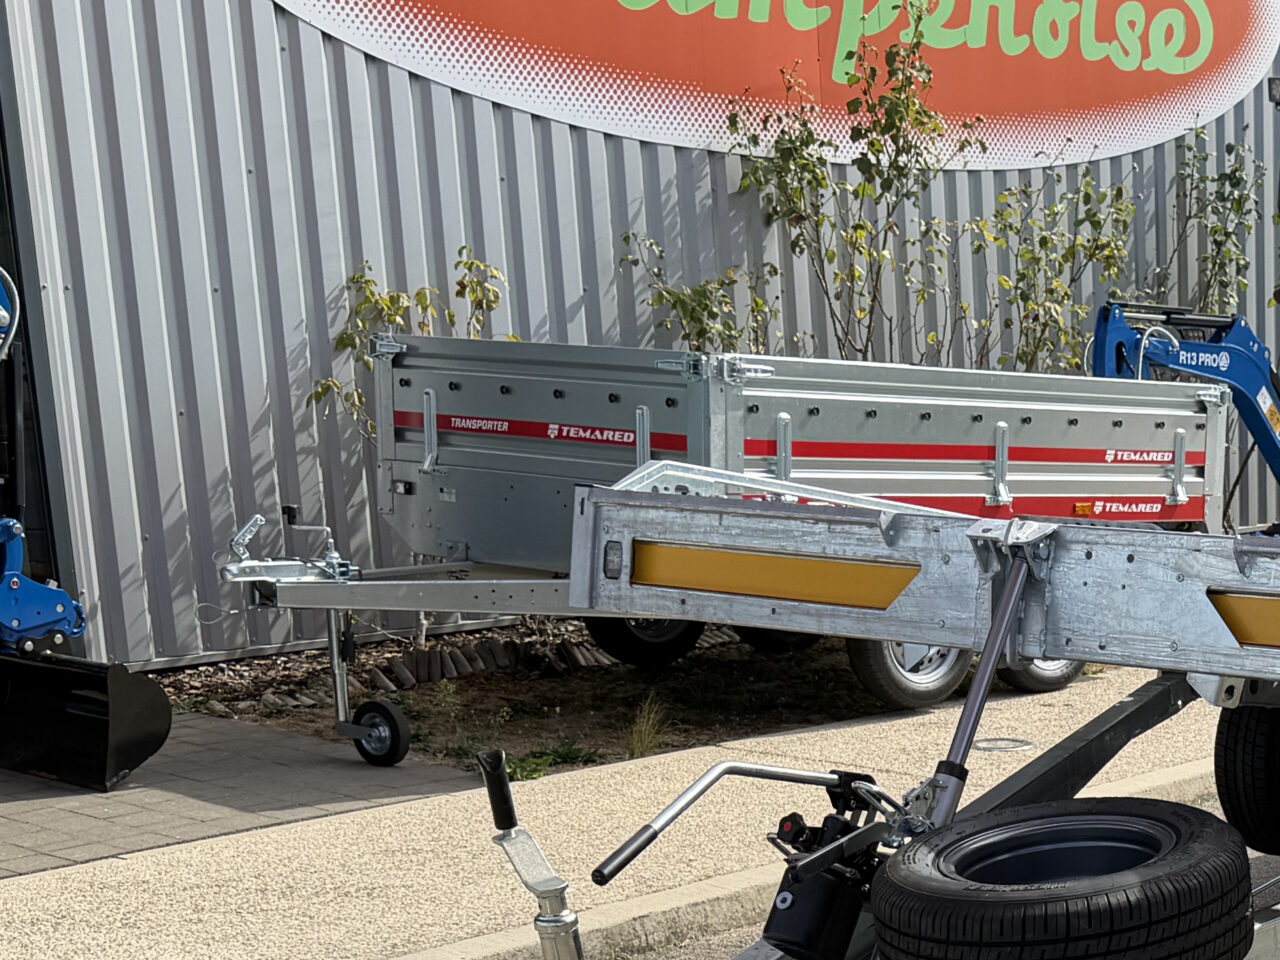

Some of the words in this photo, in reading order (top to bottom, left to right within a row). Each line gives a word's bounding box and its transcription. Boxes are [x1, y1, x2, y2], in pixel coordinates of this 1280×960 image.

[1179, 350, 1197, 366] R13
[1198, 352, 1218, 368] PRO
[450, 417, 509, 432] TRANSPORTER
[561, 425, 635, 443] TEMARED
[1116, 450, 1173, 462] TEMARED
[1104, 502, 1162, 513] TEMARED
